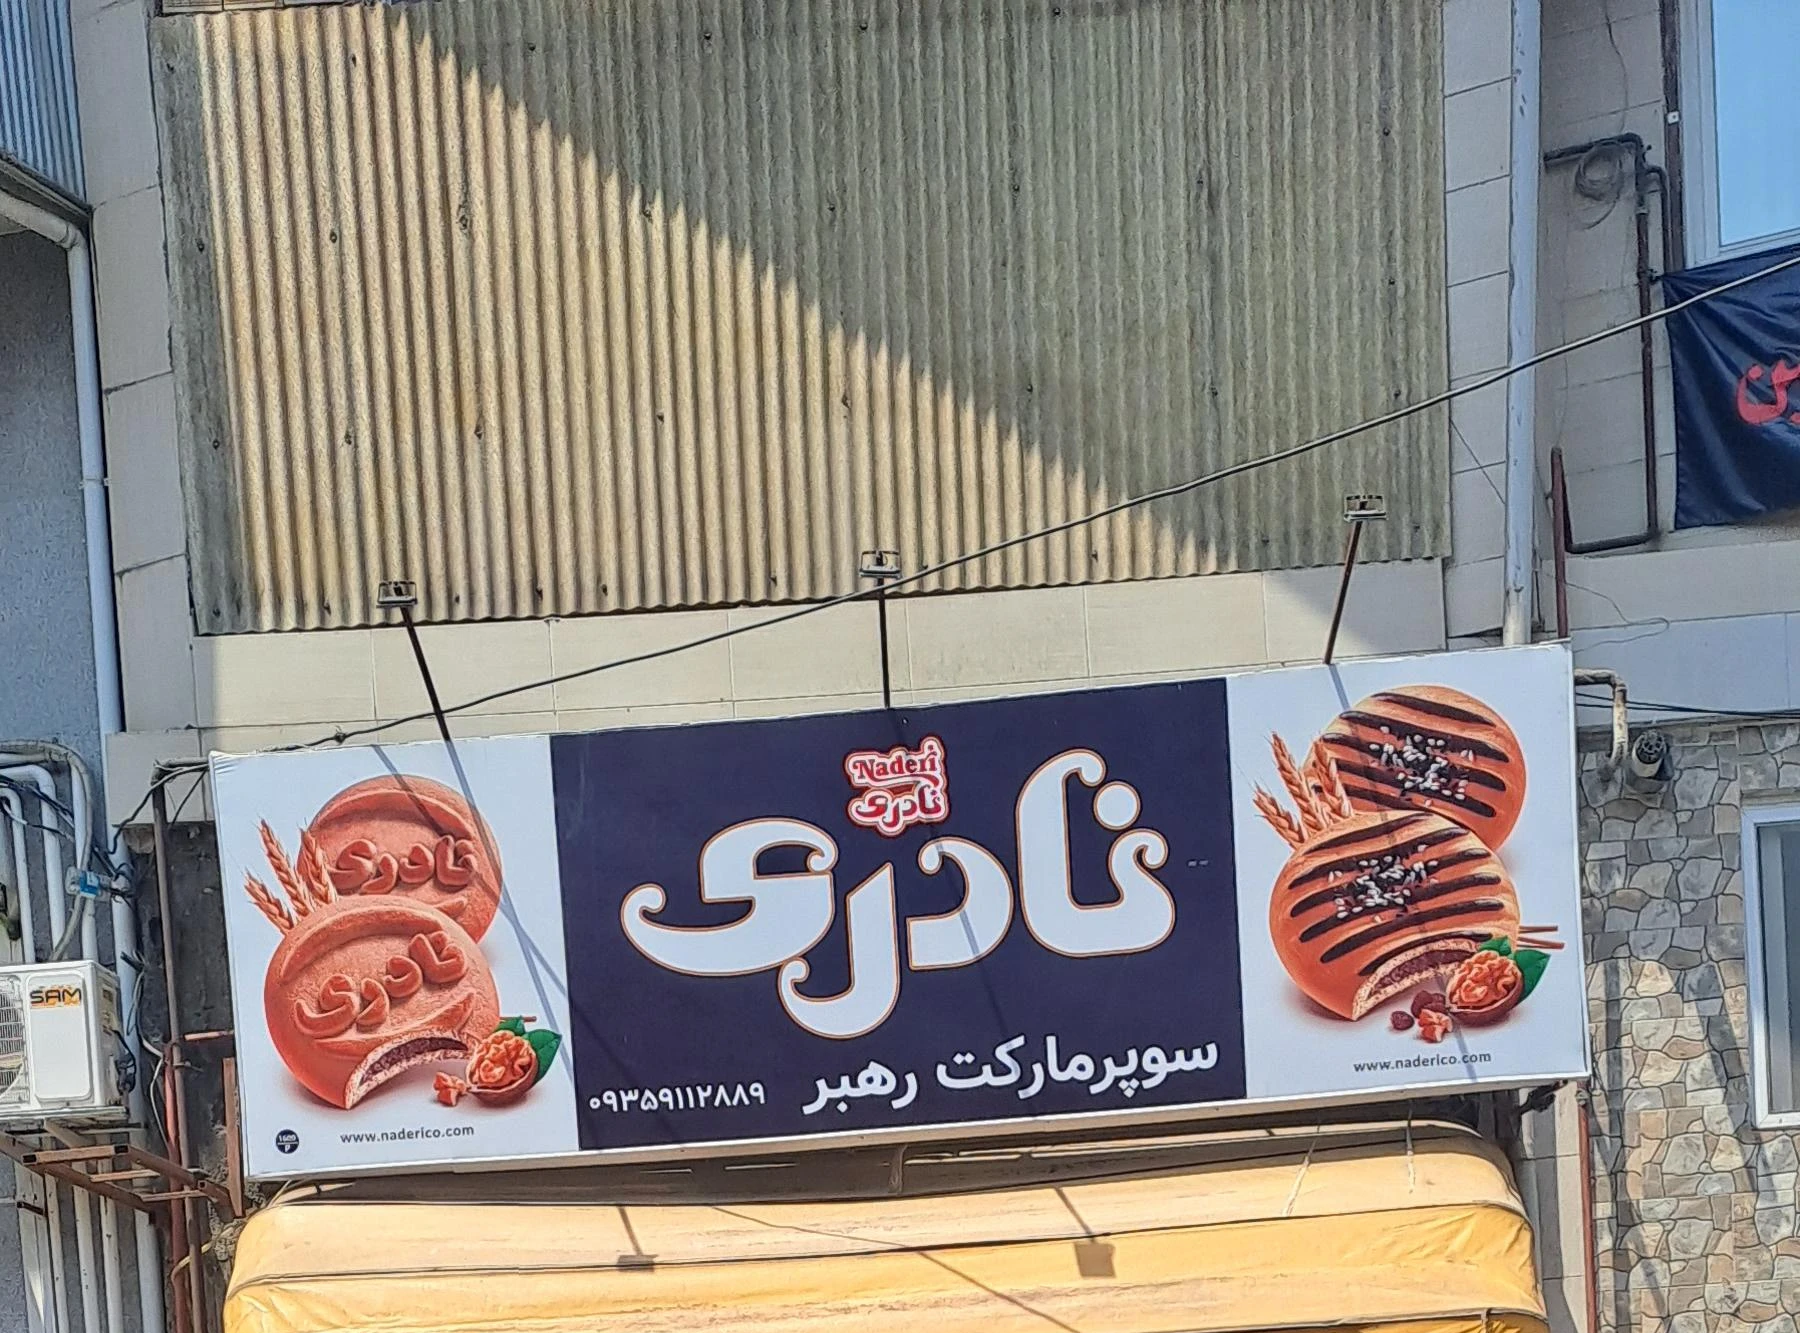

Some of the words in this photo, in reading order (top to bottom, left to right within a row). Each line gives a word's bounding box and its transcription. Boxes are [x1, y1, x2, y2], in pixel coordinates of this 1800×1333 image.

[852, 744, 940, 787] Naderi
[855, 784, 942, 828] نادری
[620, 748, 1177, 1039] نادری
[30, 987, 81, 1004] SAM
[294, 930, 467, 1036] نادری
[936, 1036, 1218, 1098] سوپرمارکت
[1353, 1051, 1492, 1073] www.naderico.com
[802, 1060, 918, 1115] رهبر
[340, 1125, 475, 1144] www.naderico.com
